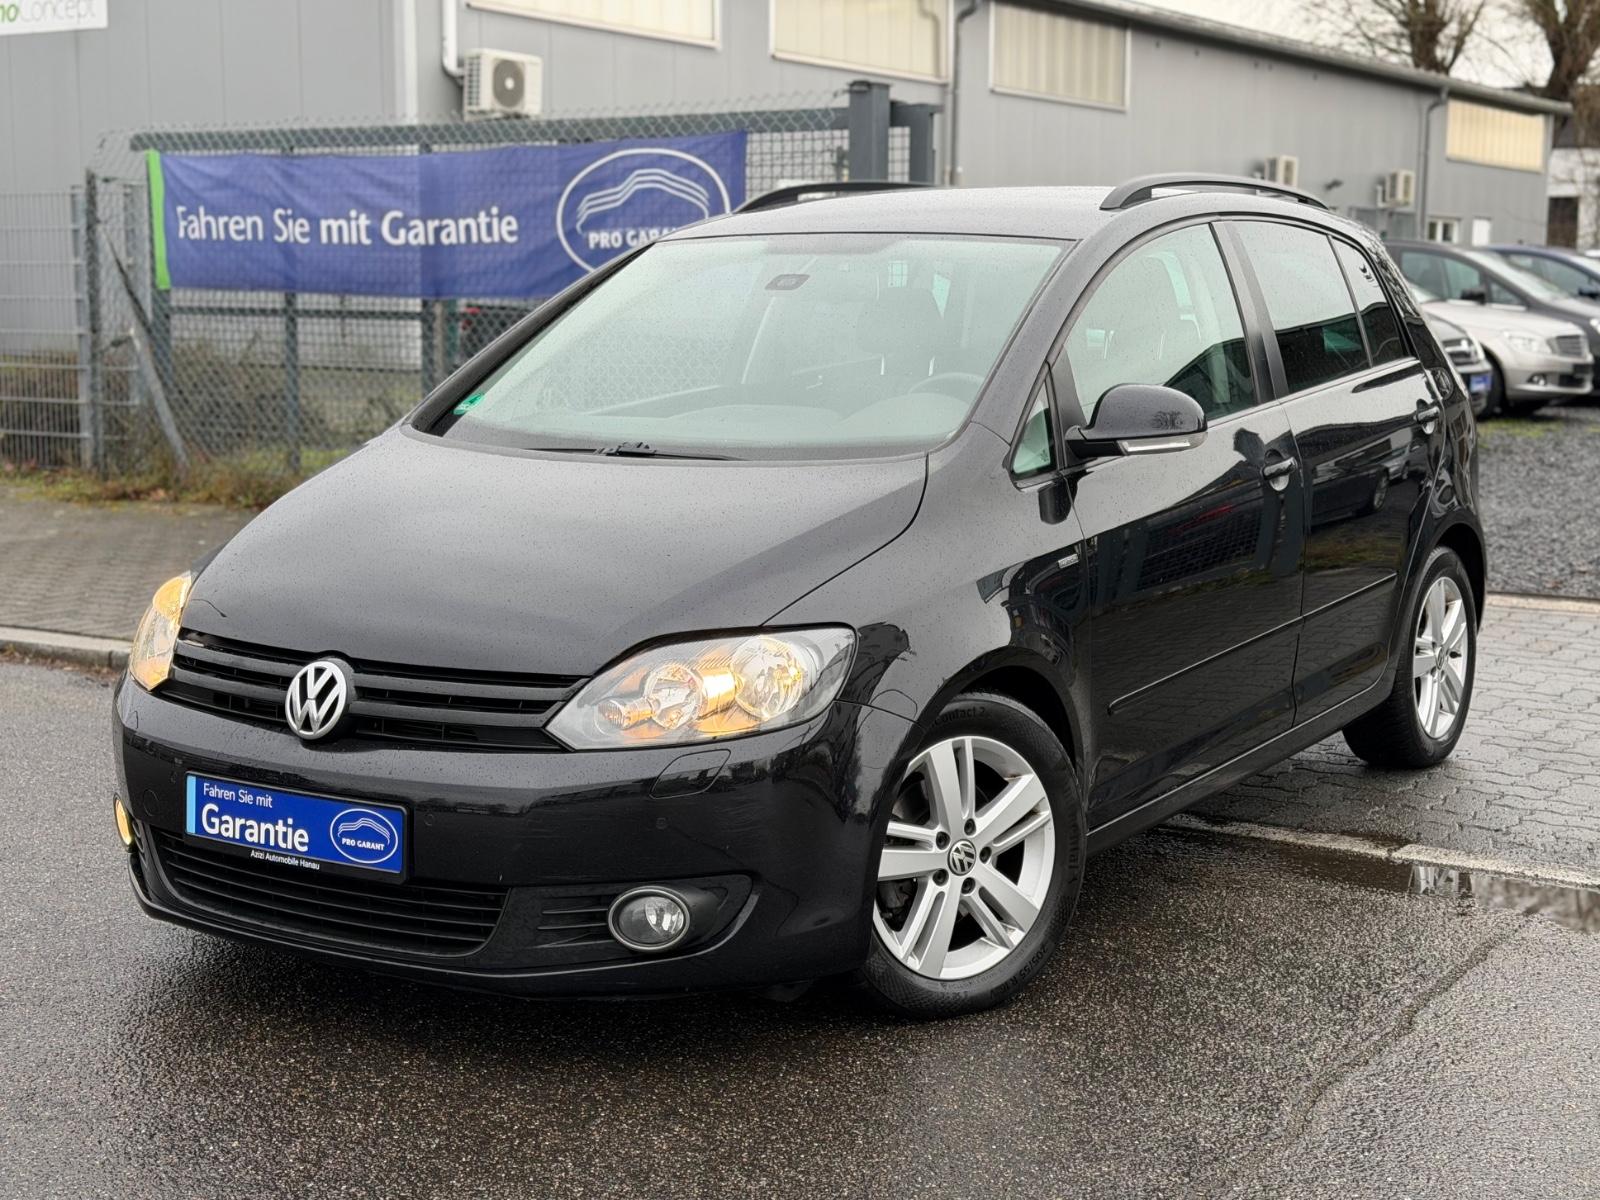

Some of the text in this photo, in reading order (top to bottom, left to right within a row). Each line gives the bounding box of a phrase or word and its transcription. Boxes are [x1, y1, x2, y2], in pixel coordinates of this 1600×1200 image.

[176, 205, 519, 246] Fahren Sie mit Garantie
[588, 230, 623, 249] PRO
[203, 782, 273, 808] Fahren Sie mit
[201, 803, 309, 852] Garantie
[341, 838, 385, 851] PRO GARANT
[250, 849, 320, 870] Azizi Automobile Hanau
